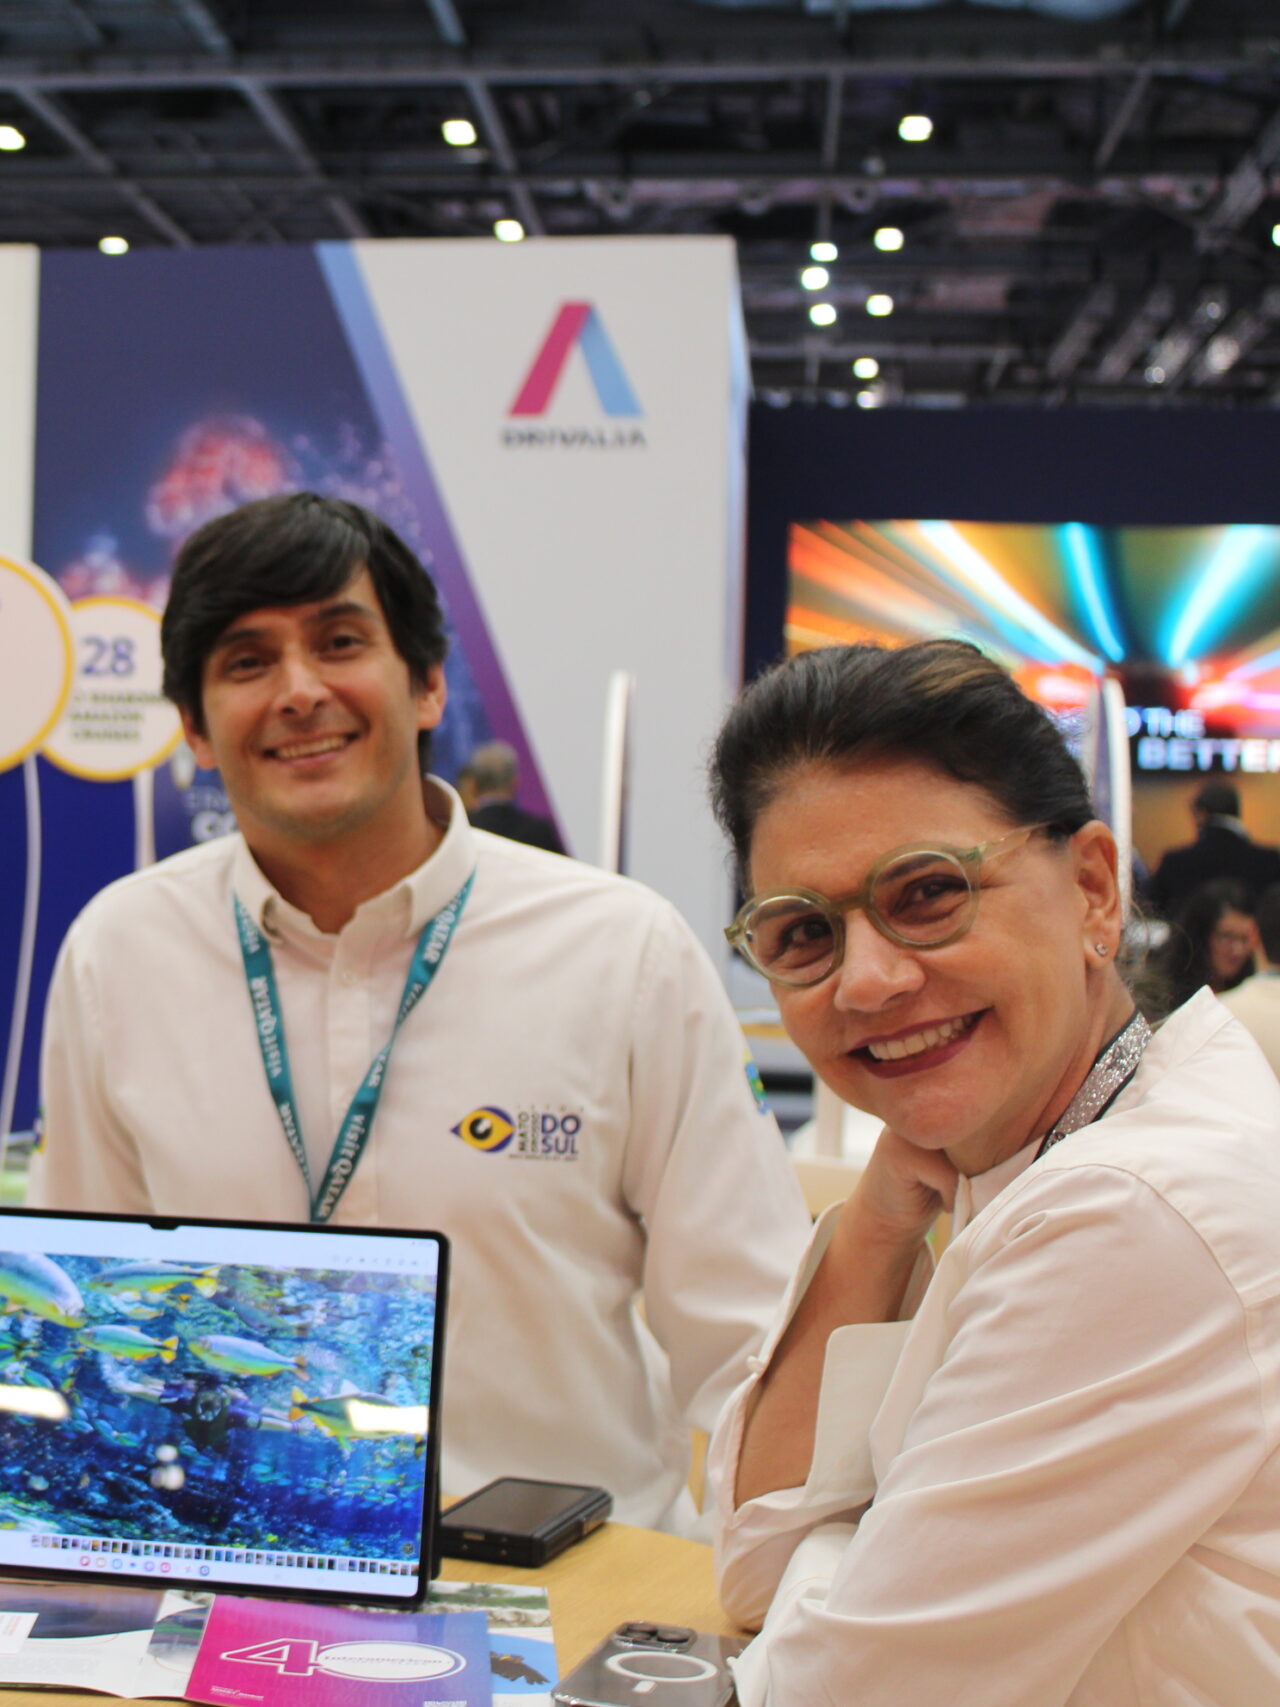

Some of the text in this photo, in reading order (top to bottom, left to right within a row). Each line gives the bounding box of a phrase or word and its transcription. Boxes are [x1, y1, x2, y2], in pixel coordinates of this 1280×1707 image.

[82, 635, 135, 677] 28
[541, 1114, 581, 1135] DO
[541, 1136, 579, 1154] SUL
